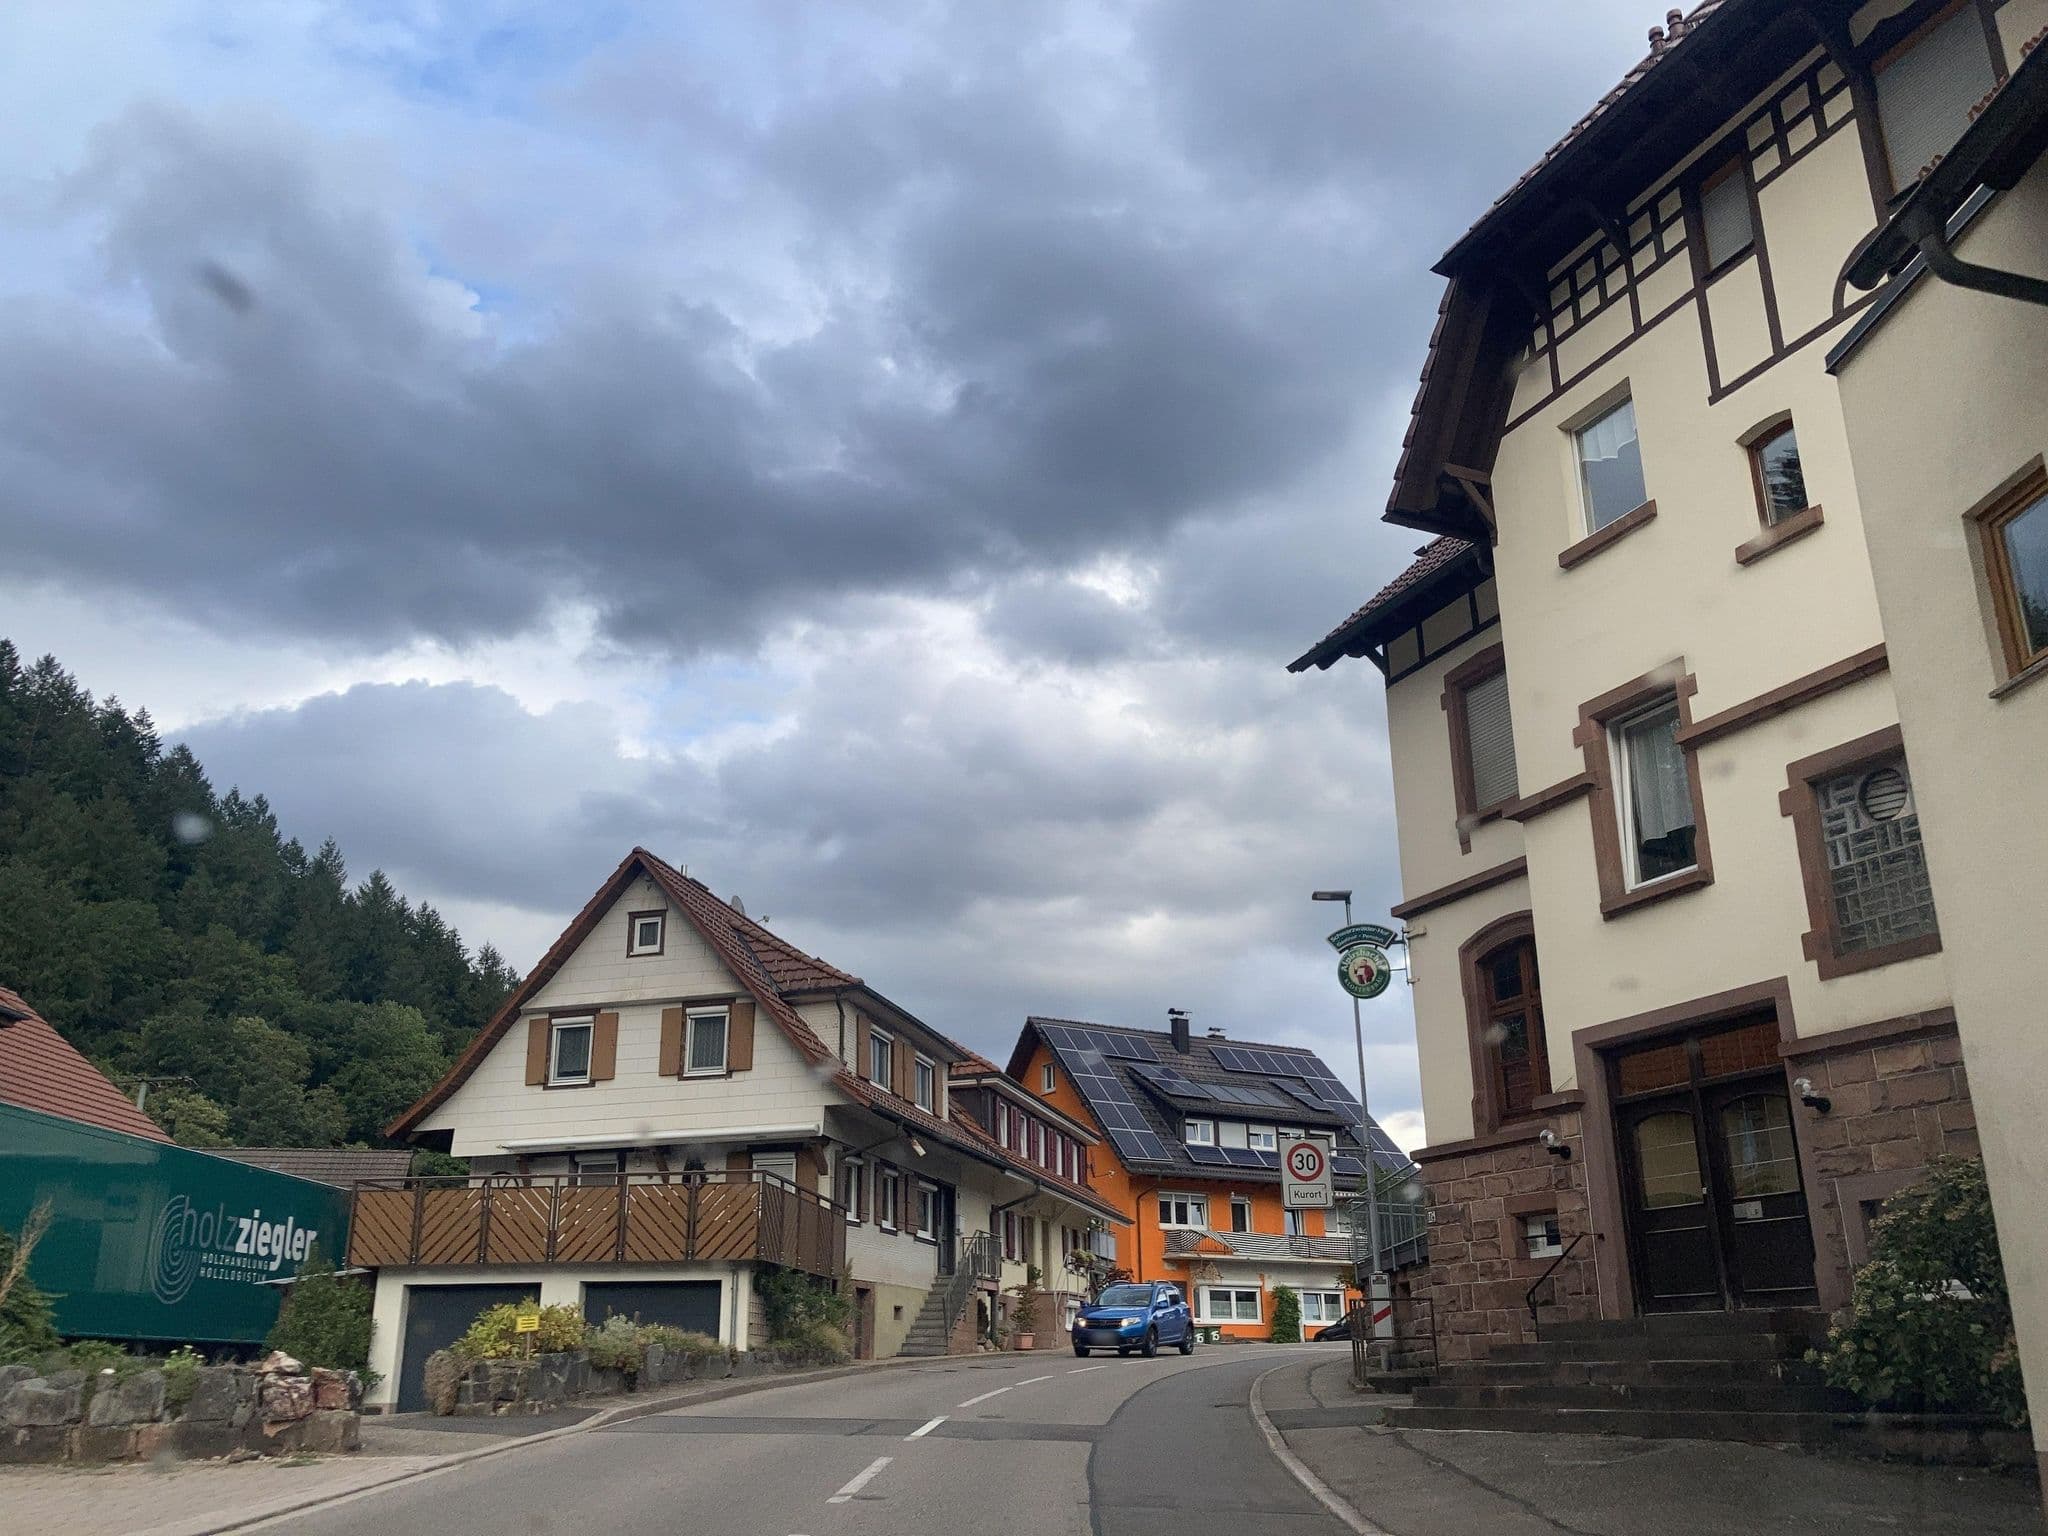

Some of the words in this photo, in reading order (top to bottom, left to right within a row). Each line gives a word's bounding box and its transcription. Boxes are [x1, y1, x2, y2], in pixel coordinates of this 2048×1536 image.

[1295, 1153, 1316, 1171] 30
[1294, 1190, 1322, 1199] Kurort
[201, 1252, 270, 1271] HOLZHANDLUNG
